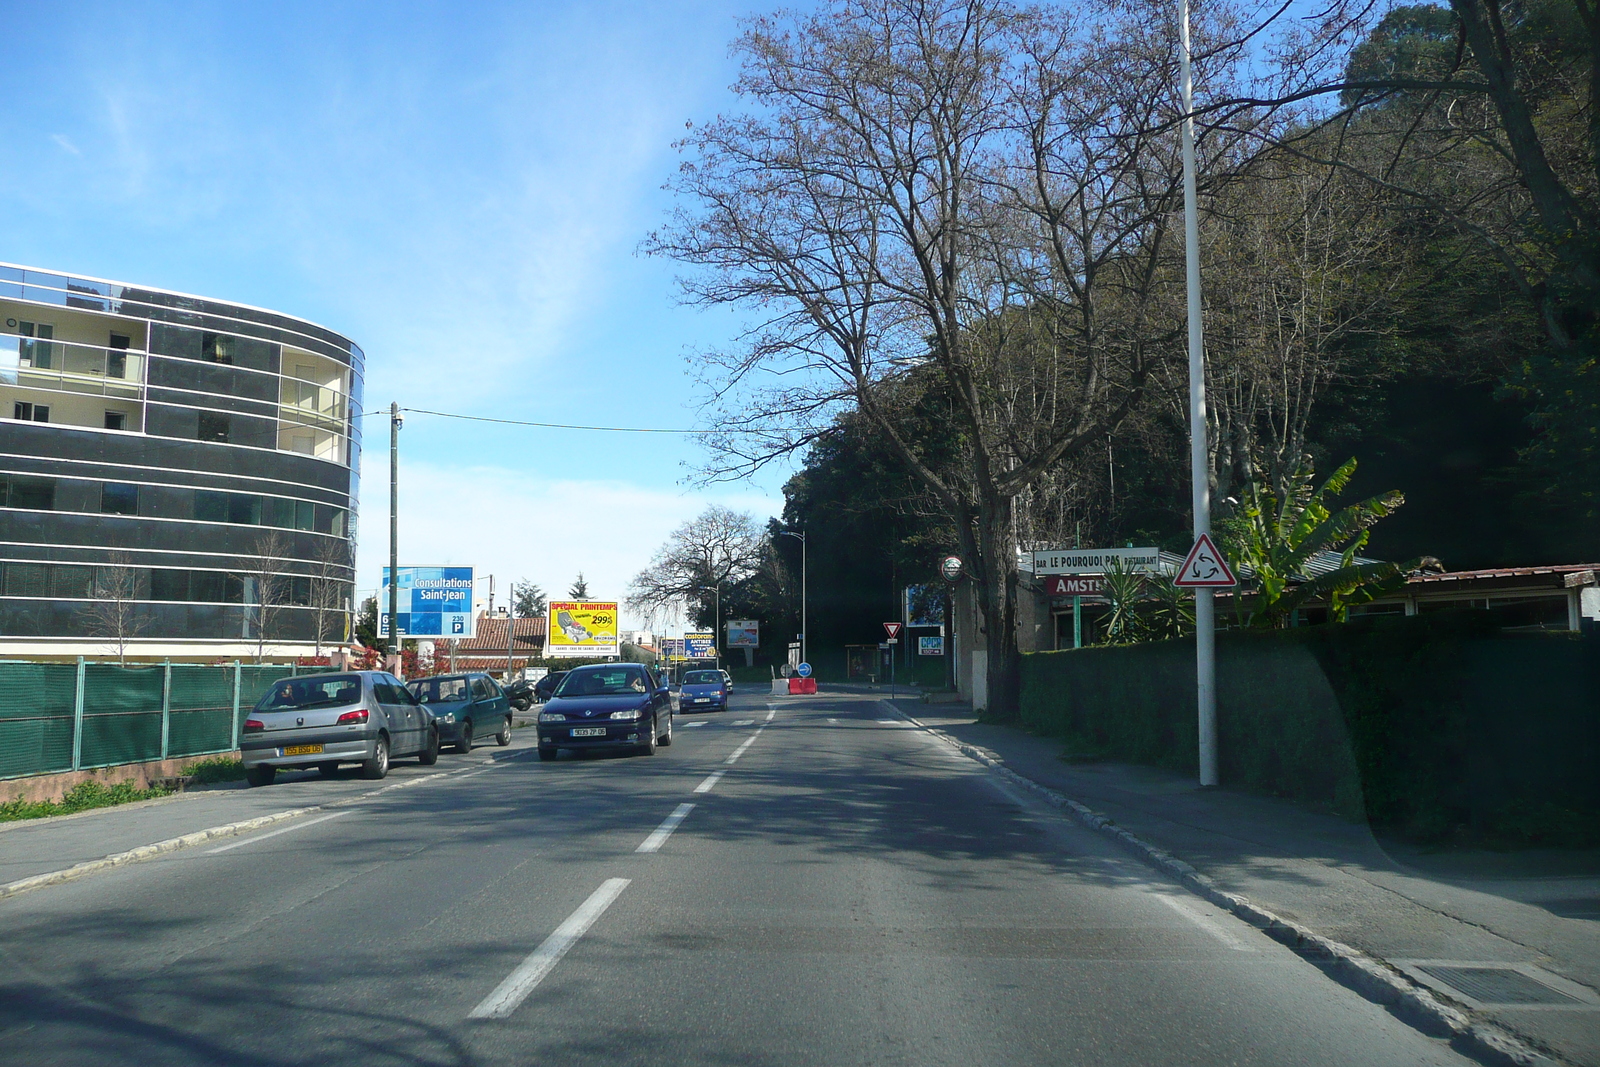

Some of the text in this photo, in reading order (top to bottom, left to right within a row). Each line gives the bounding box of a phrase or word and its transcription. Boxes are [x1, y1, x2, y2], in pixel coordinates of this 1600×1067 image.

[1036, 560, 1047, 568] BAR
[1050, 557, 1059, 568] LE
[1061, 555, 1103, 568] POURQUOI
[1105, 555, 1120, 567] PAS
[415, 577, 472, 588] Consultations
[421, 589, 466, 602] Saint-Jean
[580, 603, 617, 611] PRINTEMPS
